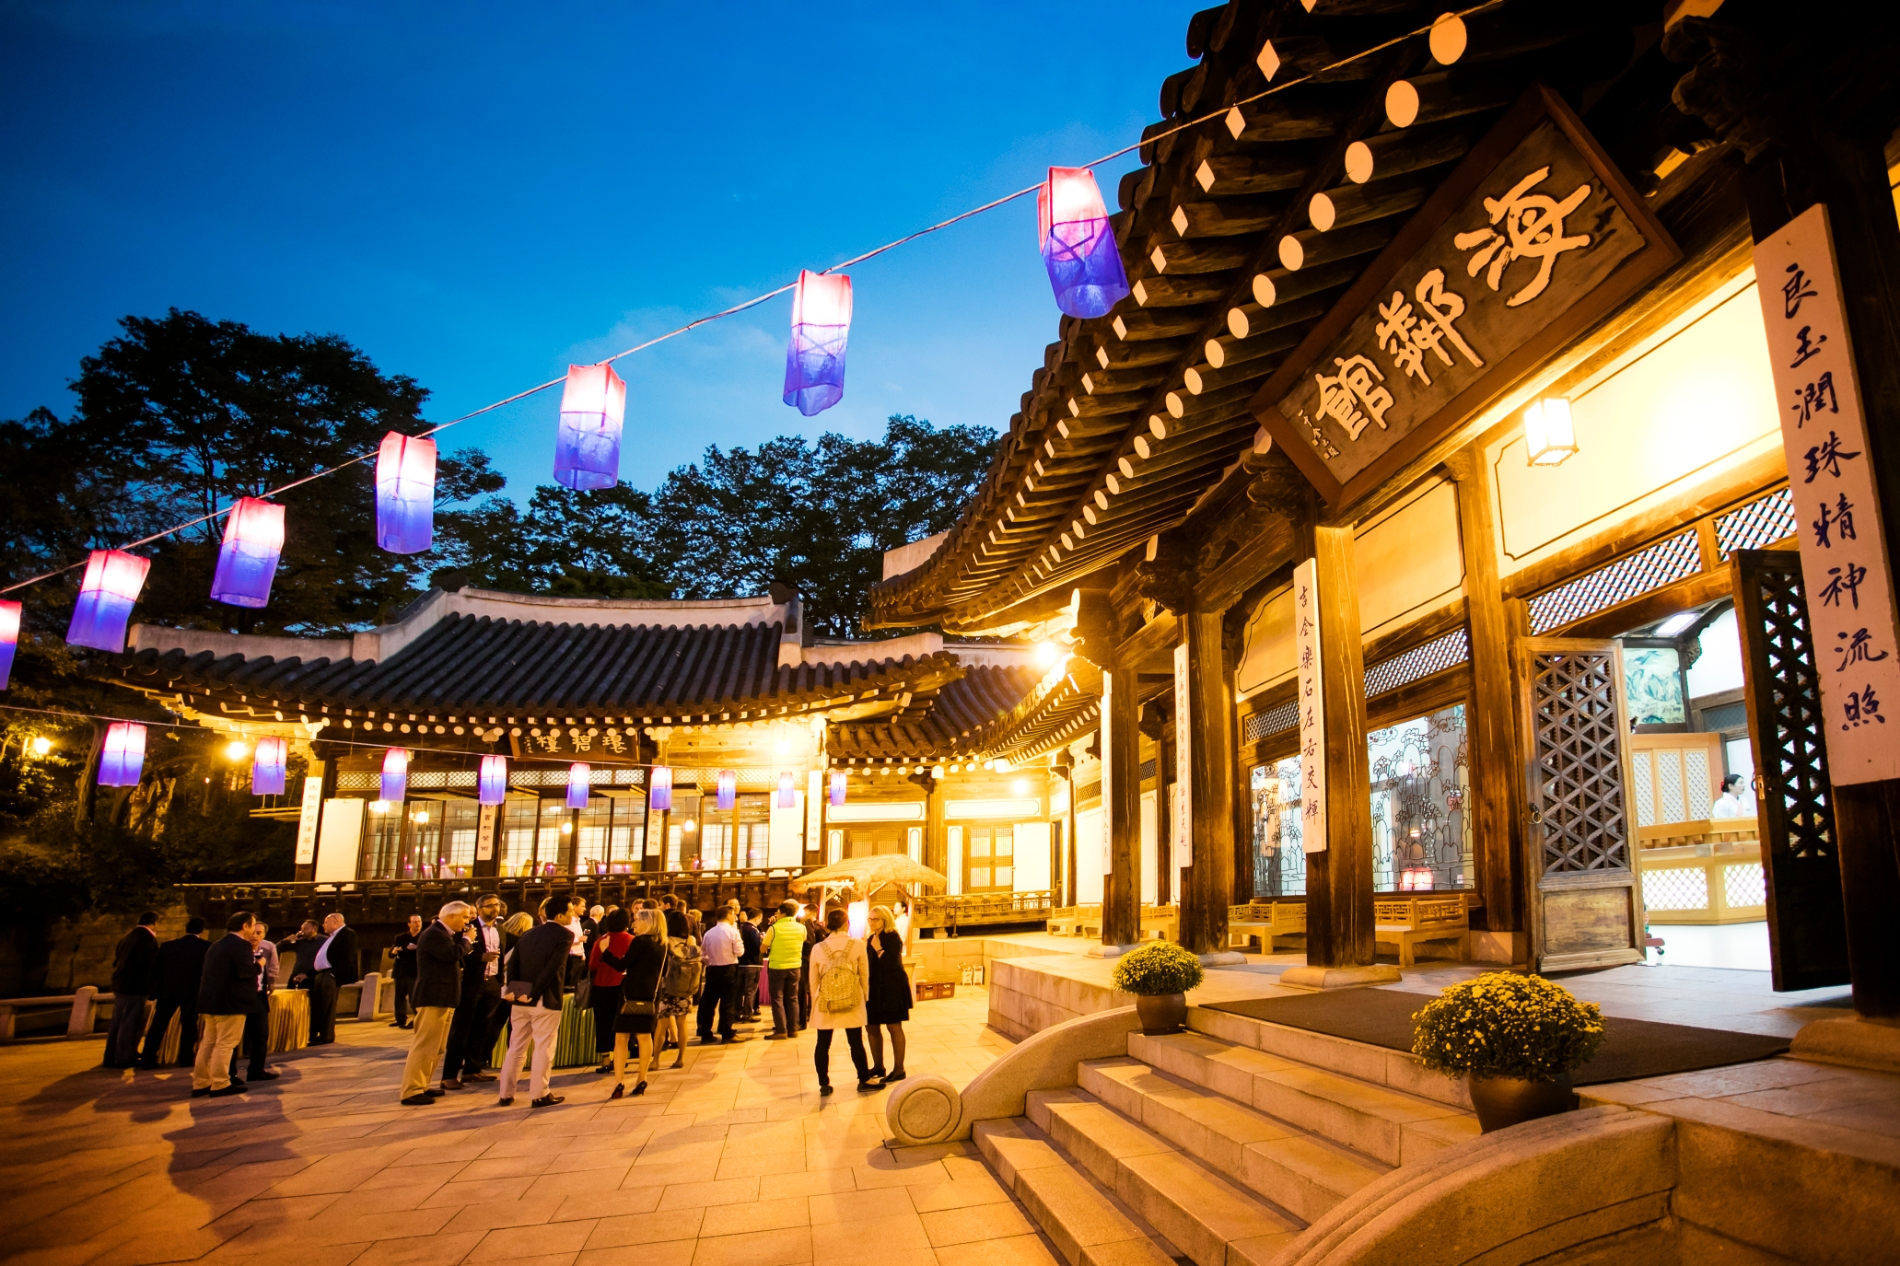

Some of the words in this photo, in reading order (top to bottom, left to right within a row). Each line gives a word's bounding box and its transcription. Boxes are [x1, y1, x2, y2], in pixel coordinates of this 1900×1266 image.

[1780, 262, 1890, 732] 良玉潤珠精神流照
